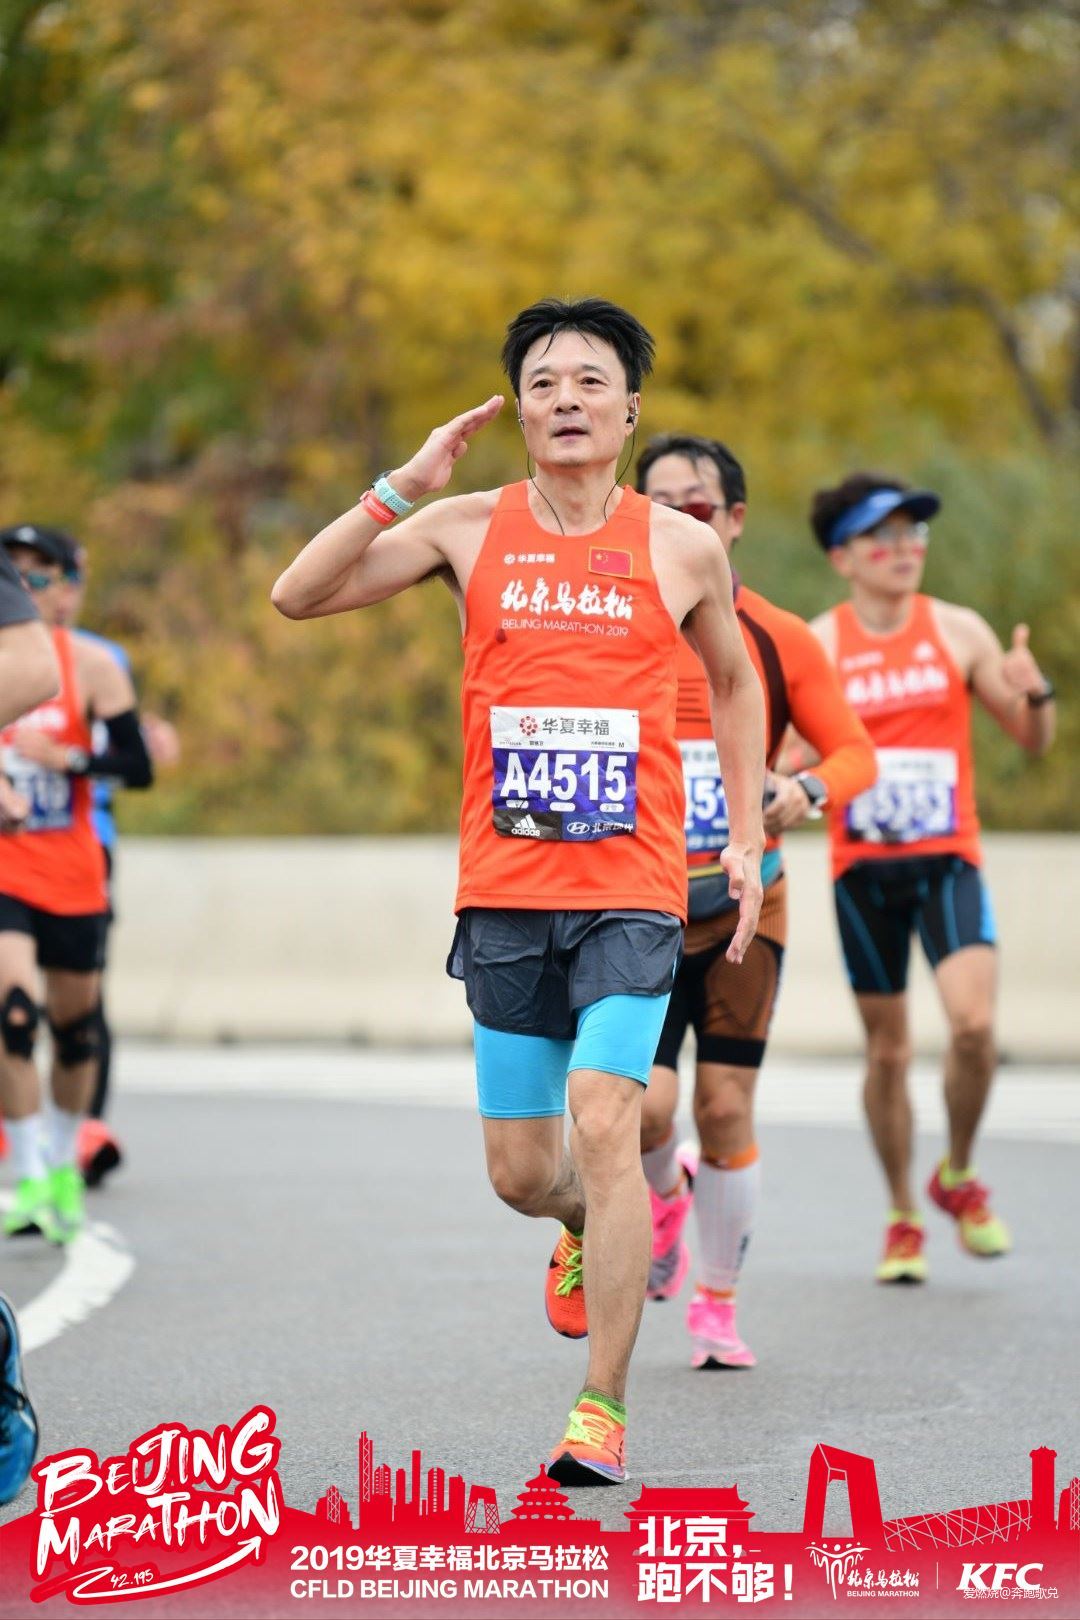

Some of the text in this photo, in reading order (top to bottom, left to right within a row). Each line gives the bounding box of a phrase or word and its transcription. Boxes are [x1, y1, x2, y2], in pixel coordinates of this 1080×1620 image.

[501, 577, 633, 620] 北京马拉松
[501, 619, 629, 637] BEIJING MARATHON 2019
[542, 718, 610, 736] 华夏幸福
[500, 752, 627, 801] A4515
[511, 828, 541, 836] adidas
